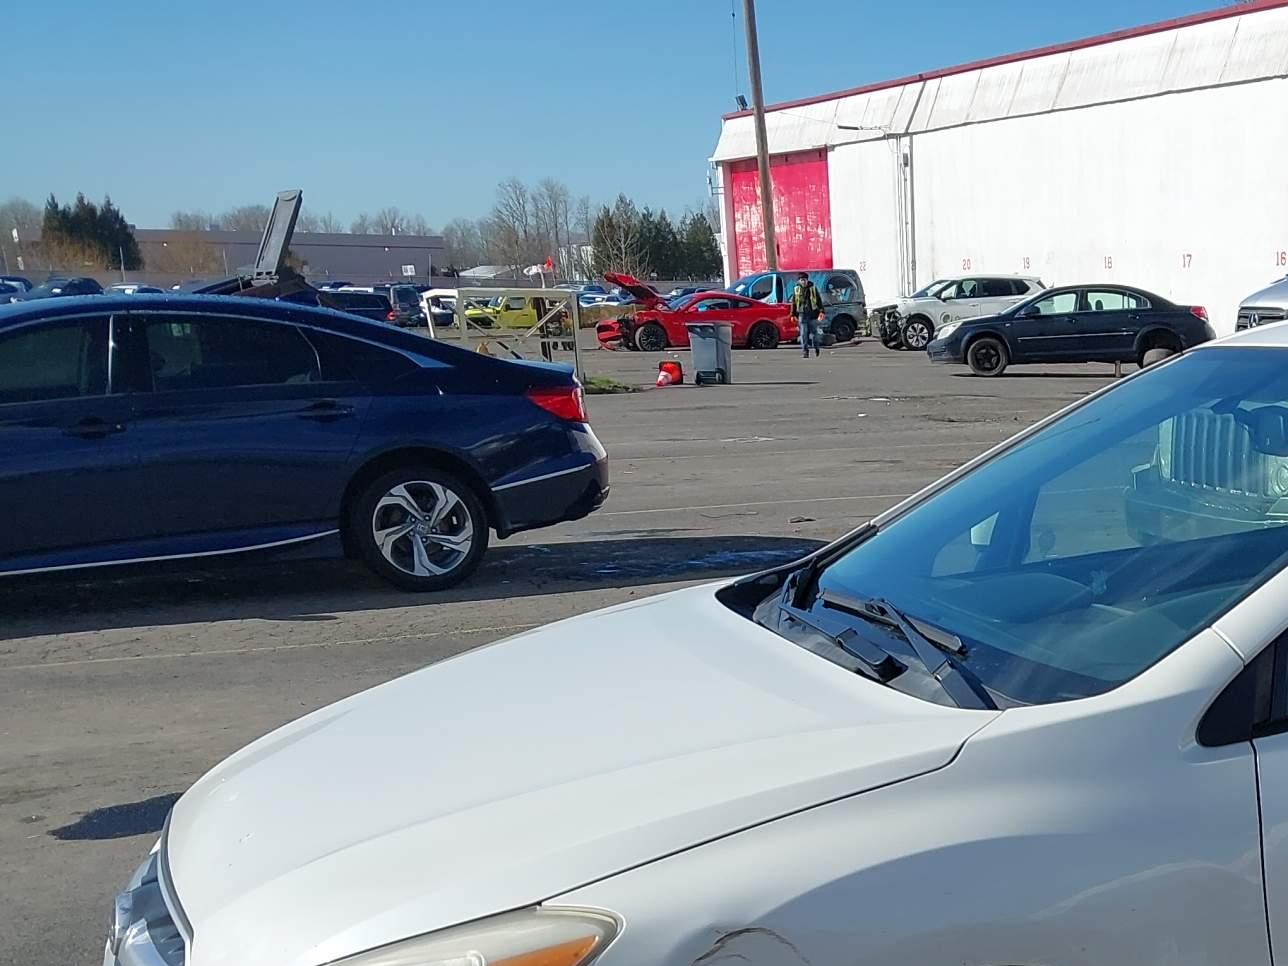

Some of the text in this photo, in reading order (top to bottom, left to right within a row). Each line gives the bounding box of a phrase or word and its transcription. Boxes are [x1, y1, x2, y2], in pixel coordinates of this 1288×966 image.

[962, 258, 972, 271] 20
[1182, 253, 1193, 269] 17
[1275, 251, 1287, 266] 16
